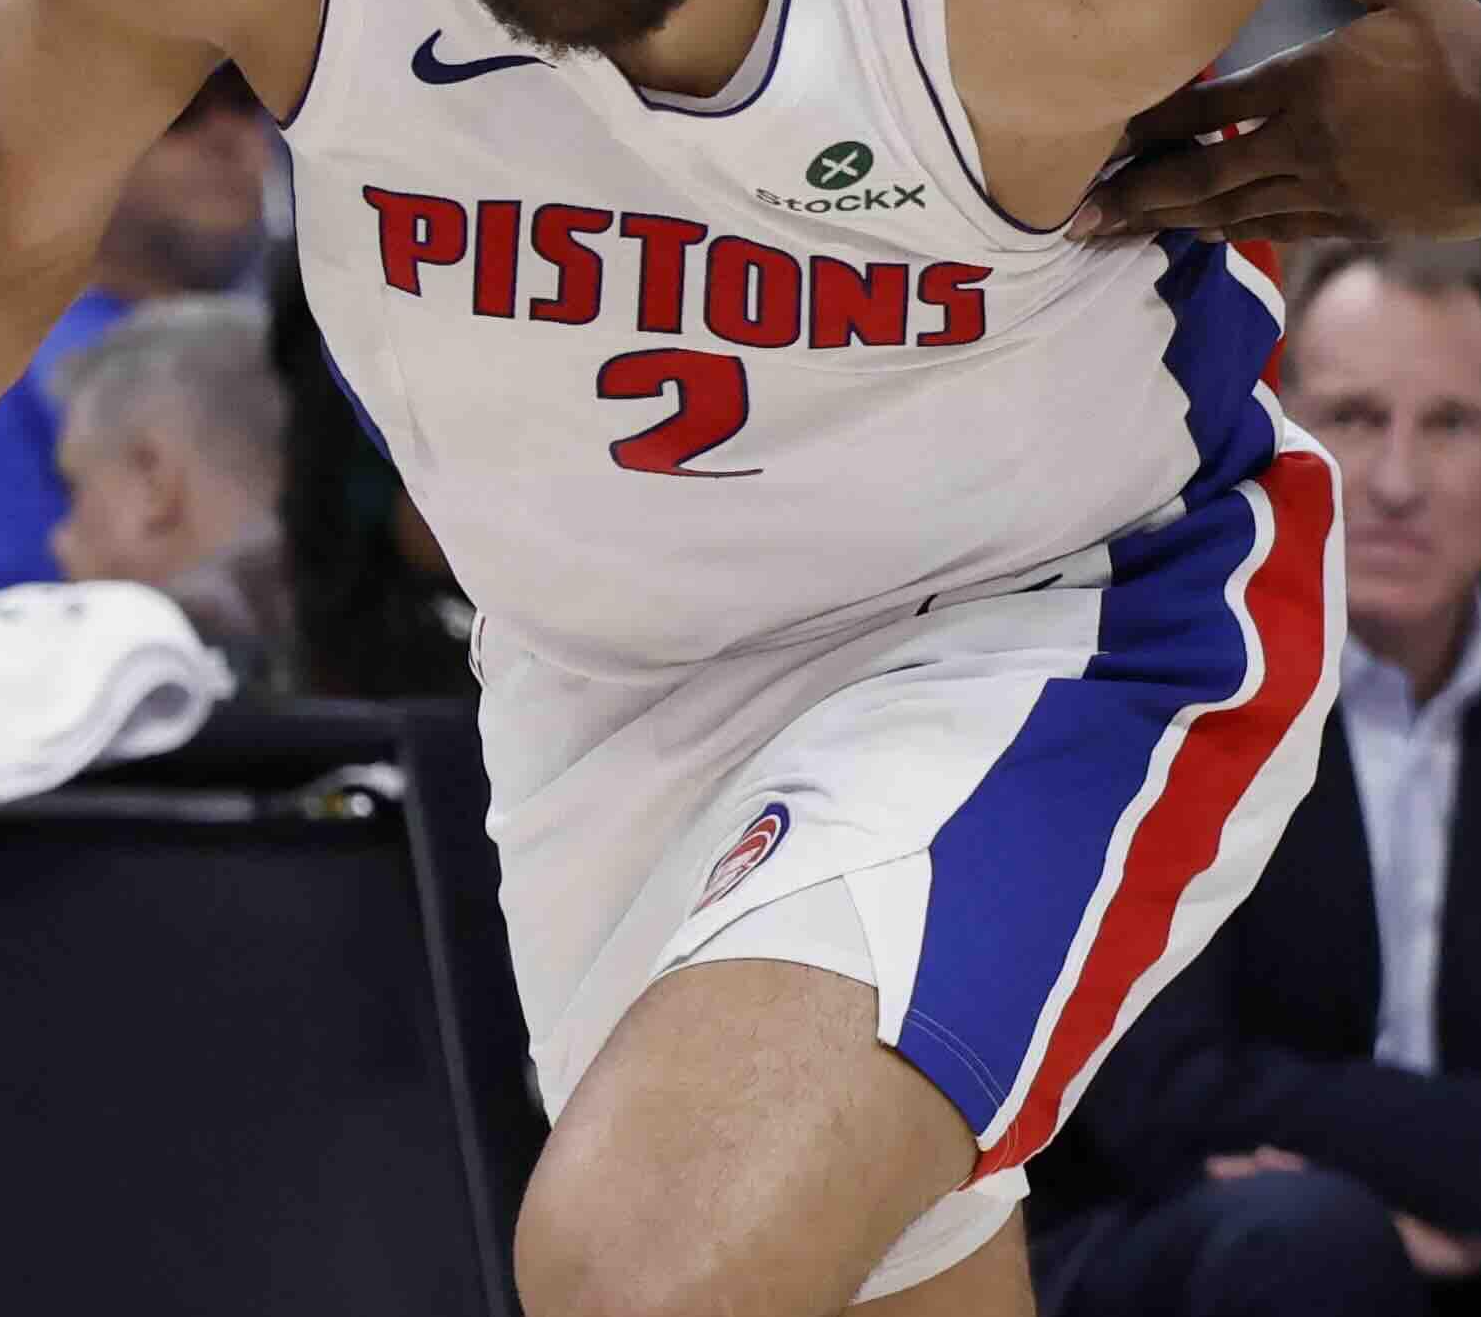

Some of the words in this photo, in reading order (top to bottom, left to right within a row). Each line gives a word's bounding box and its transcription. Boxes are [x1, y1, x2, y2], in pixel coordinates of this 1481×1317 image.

[755, 183, 926, 214] StockX
[362, 184, 994, 349] PISTONS
[596, 347, 763, 477] 2
